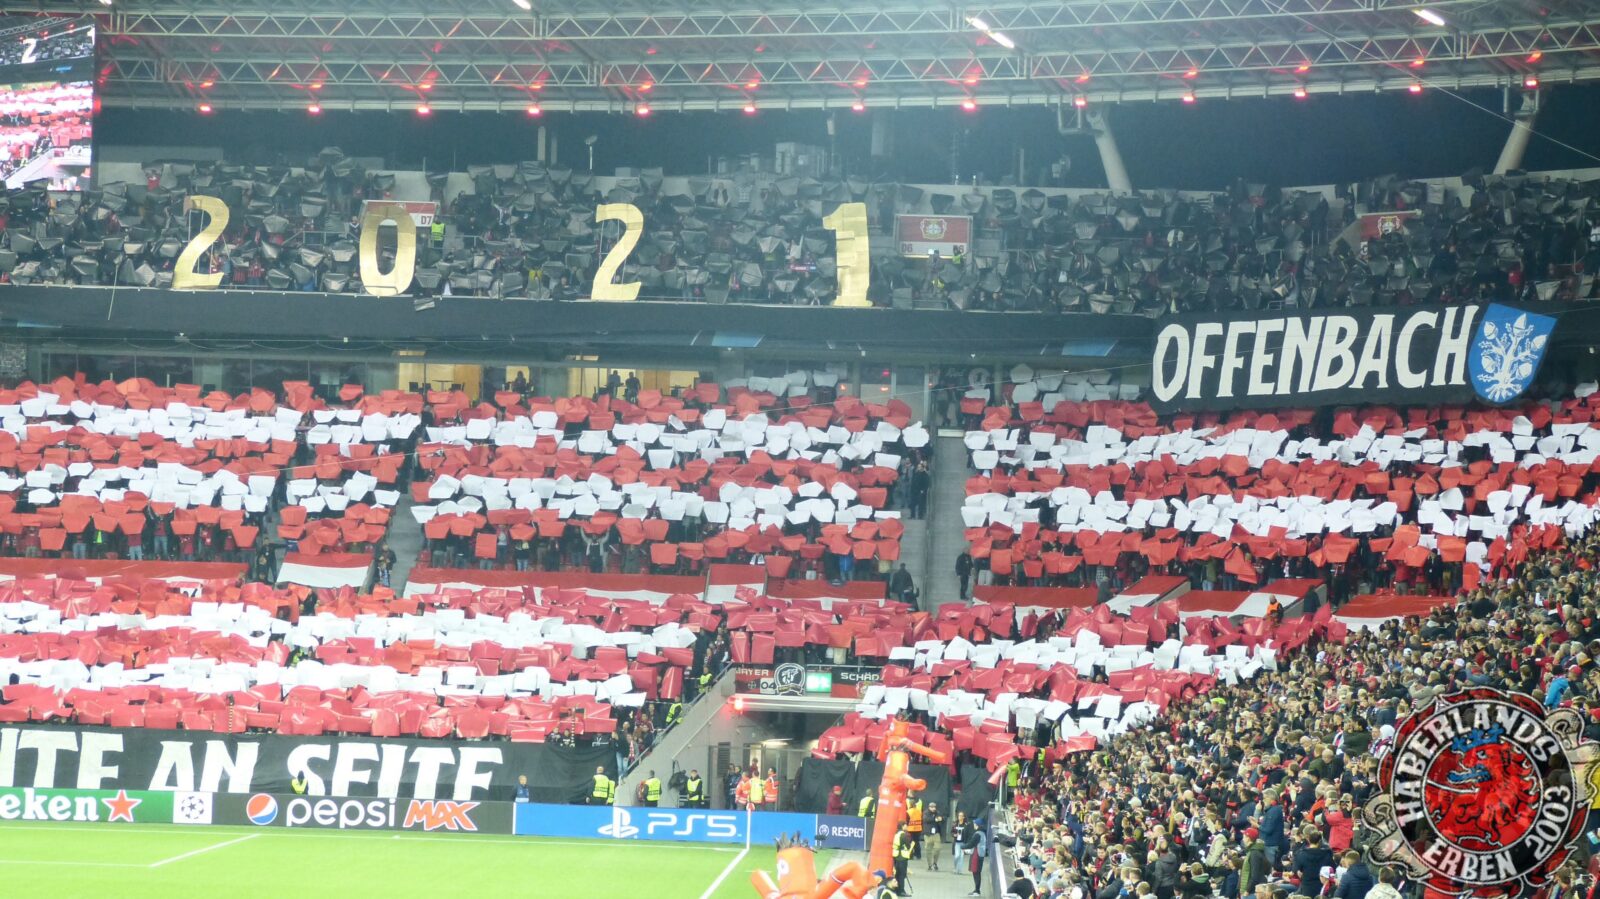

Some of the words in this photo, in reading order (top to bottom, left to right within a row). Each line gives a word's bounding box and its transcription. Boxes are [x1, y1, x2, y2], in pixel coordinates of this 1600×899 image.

[1152, 305, 1479, 402] OFFENBACH
[840, 672, 884, 681] SCHÄD
[148, 740, 260, 793] AN
[0, 787, 99, 821] eken
[286, 798, 395, 829] pepsi
[403, 799, 480, 831] MAX
[647, 813, 737, 837] PS5
[831, 826, 865, 838] RESPECT
